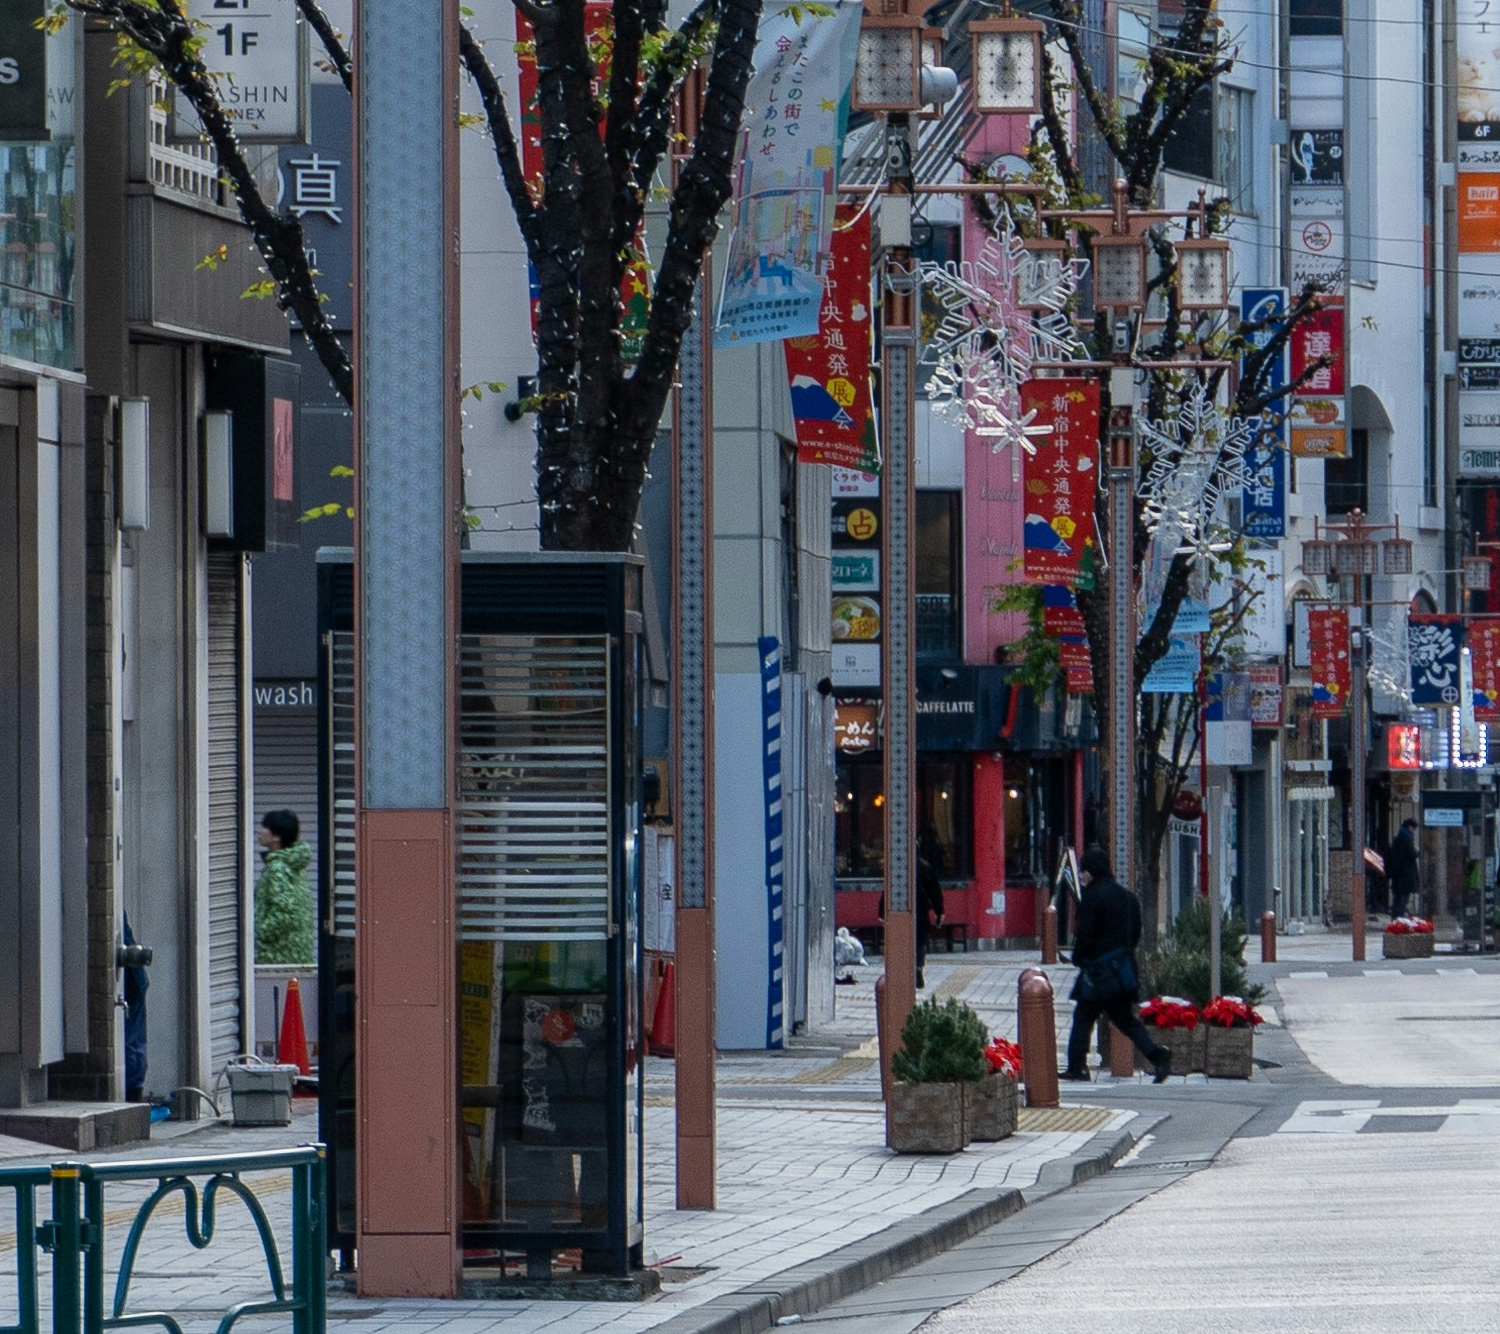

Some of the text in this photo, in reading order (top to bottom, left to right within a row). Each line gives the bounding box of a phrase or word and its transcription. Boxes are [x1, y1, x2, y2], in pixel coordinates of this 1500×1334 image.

[216, 31, 259, 57] 1F
[192, 85, 291, 105] ASHIN
[1474, 124, 1492, 138] 6F
[288, 152, 343, 225] 真
[852, 510, 873, 538] 占
[254, 682, 314, 707] wash
